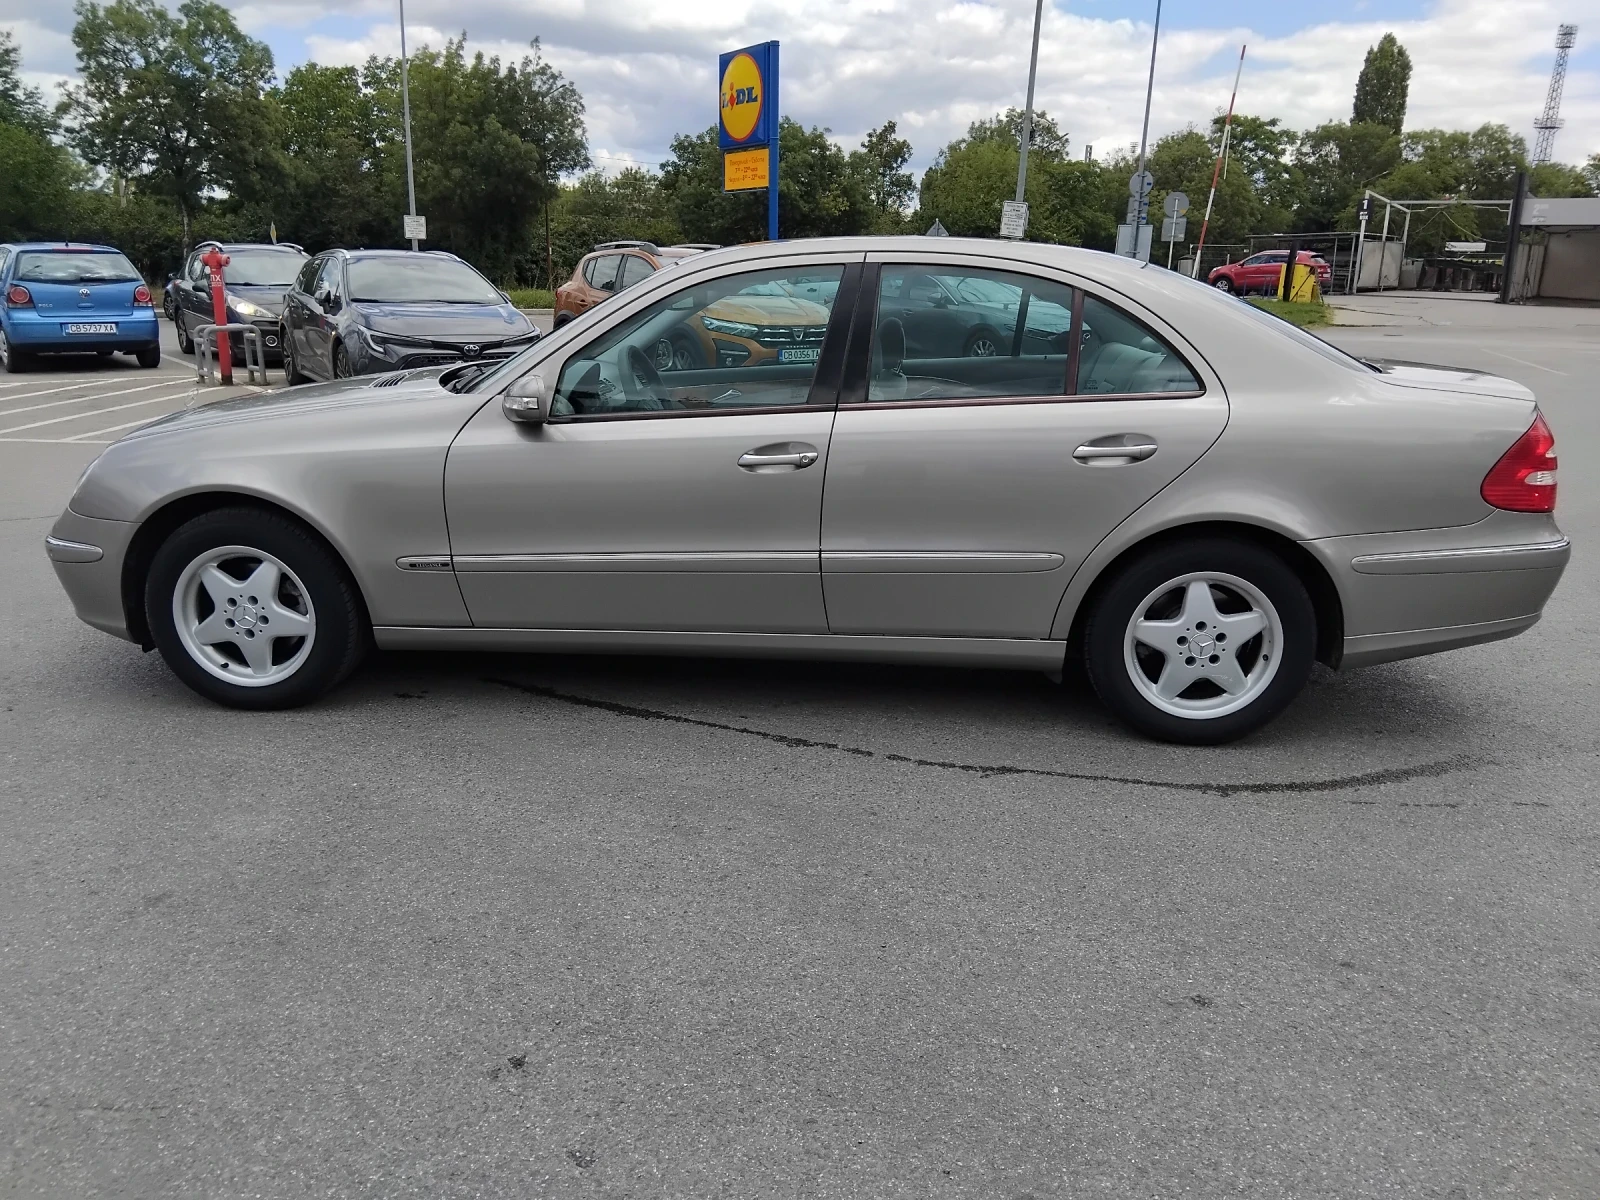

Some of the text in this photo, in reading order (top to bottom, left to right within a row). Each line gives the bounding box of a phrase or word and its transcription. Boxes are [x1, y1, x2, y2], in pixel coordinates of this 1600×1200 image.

[721, 81, 758, 110] LIDL
[70, 324, 115, 333] CB 5737 XA
[784, 350, 793, 360] CB
[793, 350, 811, 359] 0356
